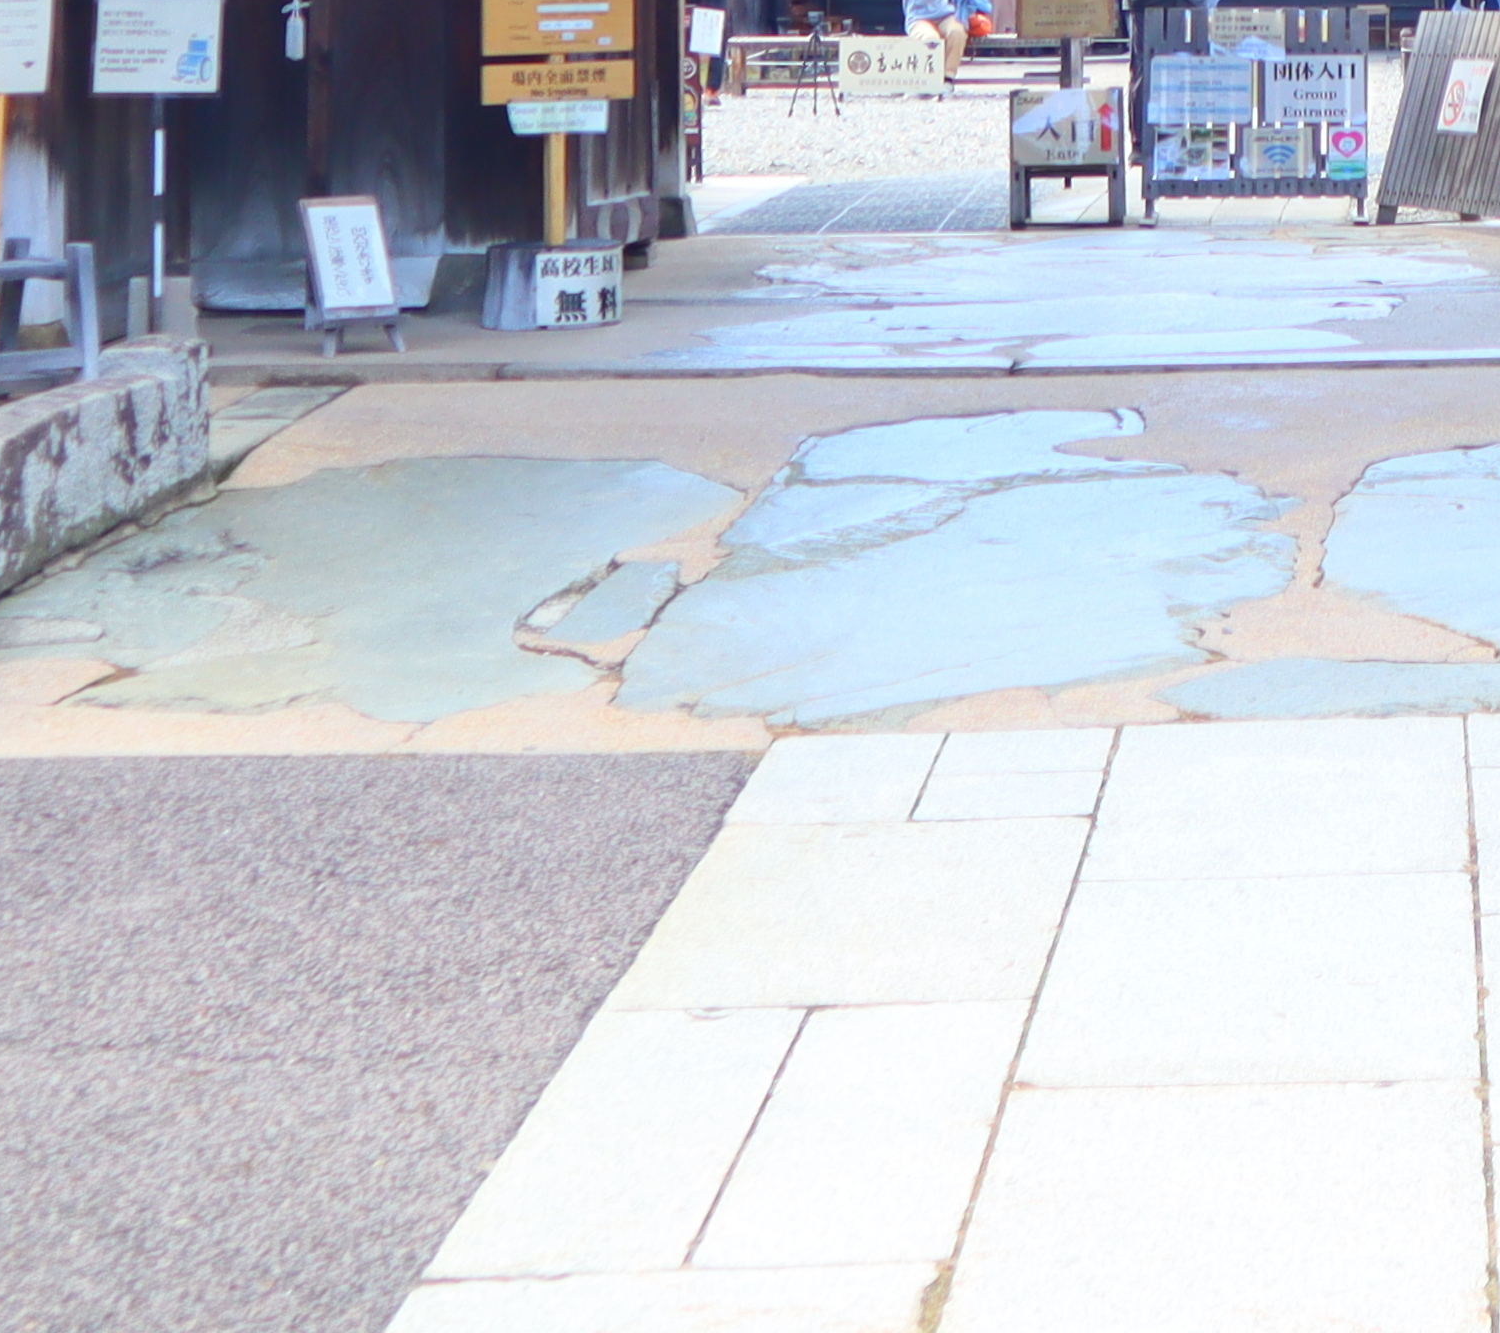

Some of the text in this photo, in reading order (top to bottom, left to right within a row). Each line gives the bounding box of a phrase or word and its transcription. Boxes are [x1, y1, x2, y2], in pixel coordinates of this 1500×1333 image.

[877, 52, 935, 75] 高山陣屋
[1274, 61, 1355, 81] 団体入口
[512, 68, 606, 85] 場内全面禁煙
[531, 87, 588, 97] No Smoking
[1293, 89, 1337, 101] Group
[1283, 106, 1348, 117] Entrance
[1036, 115, 1095, 143] 入口
[541, 255, 619, 278] 高校生以
[554, 285, 617, 323] 無料
